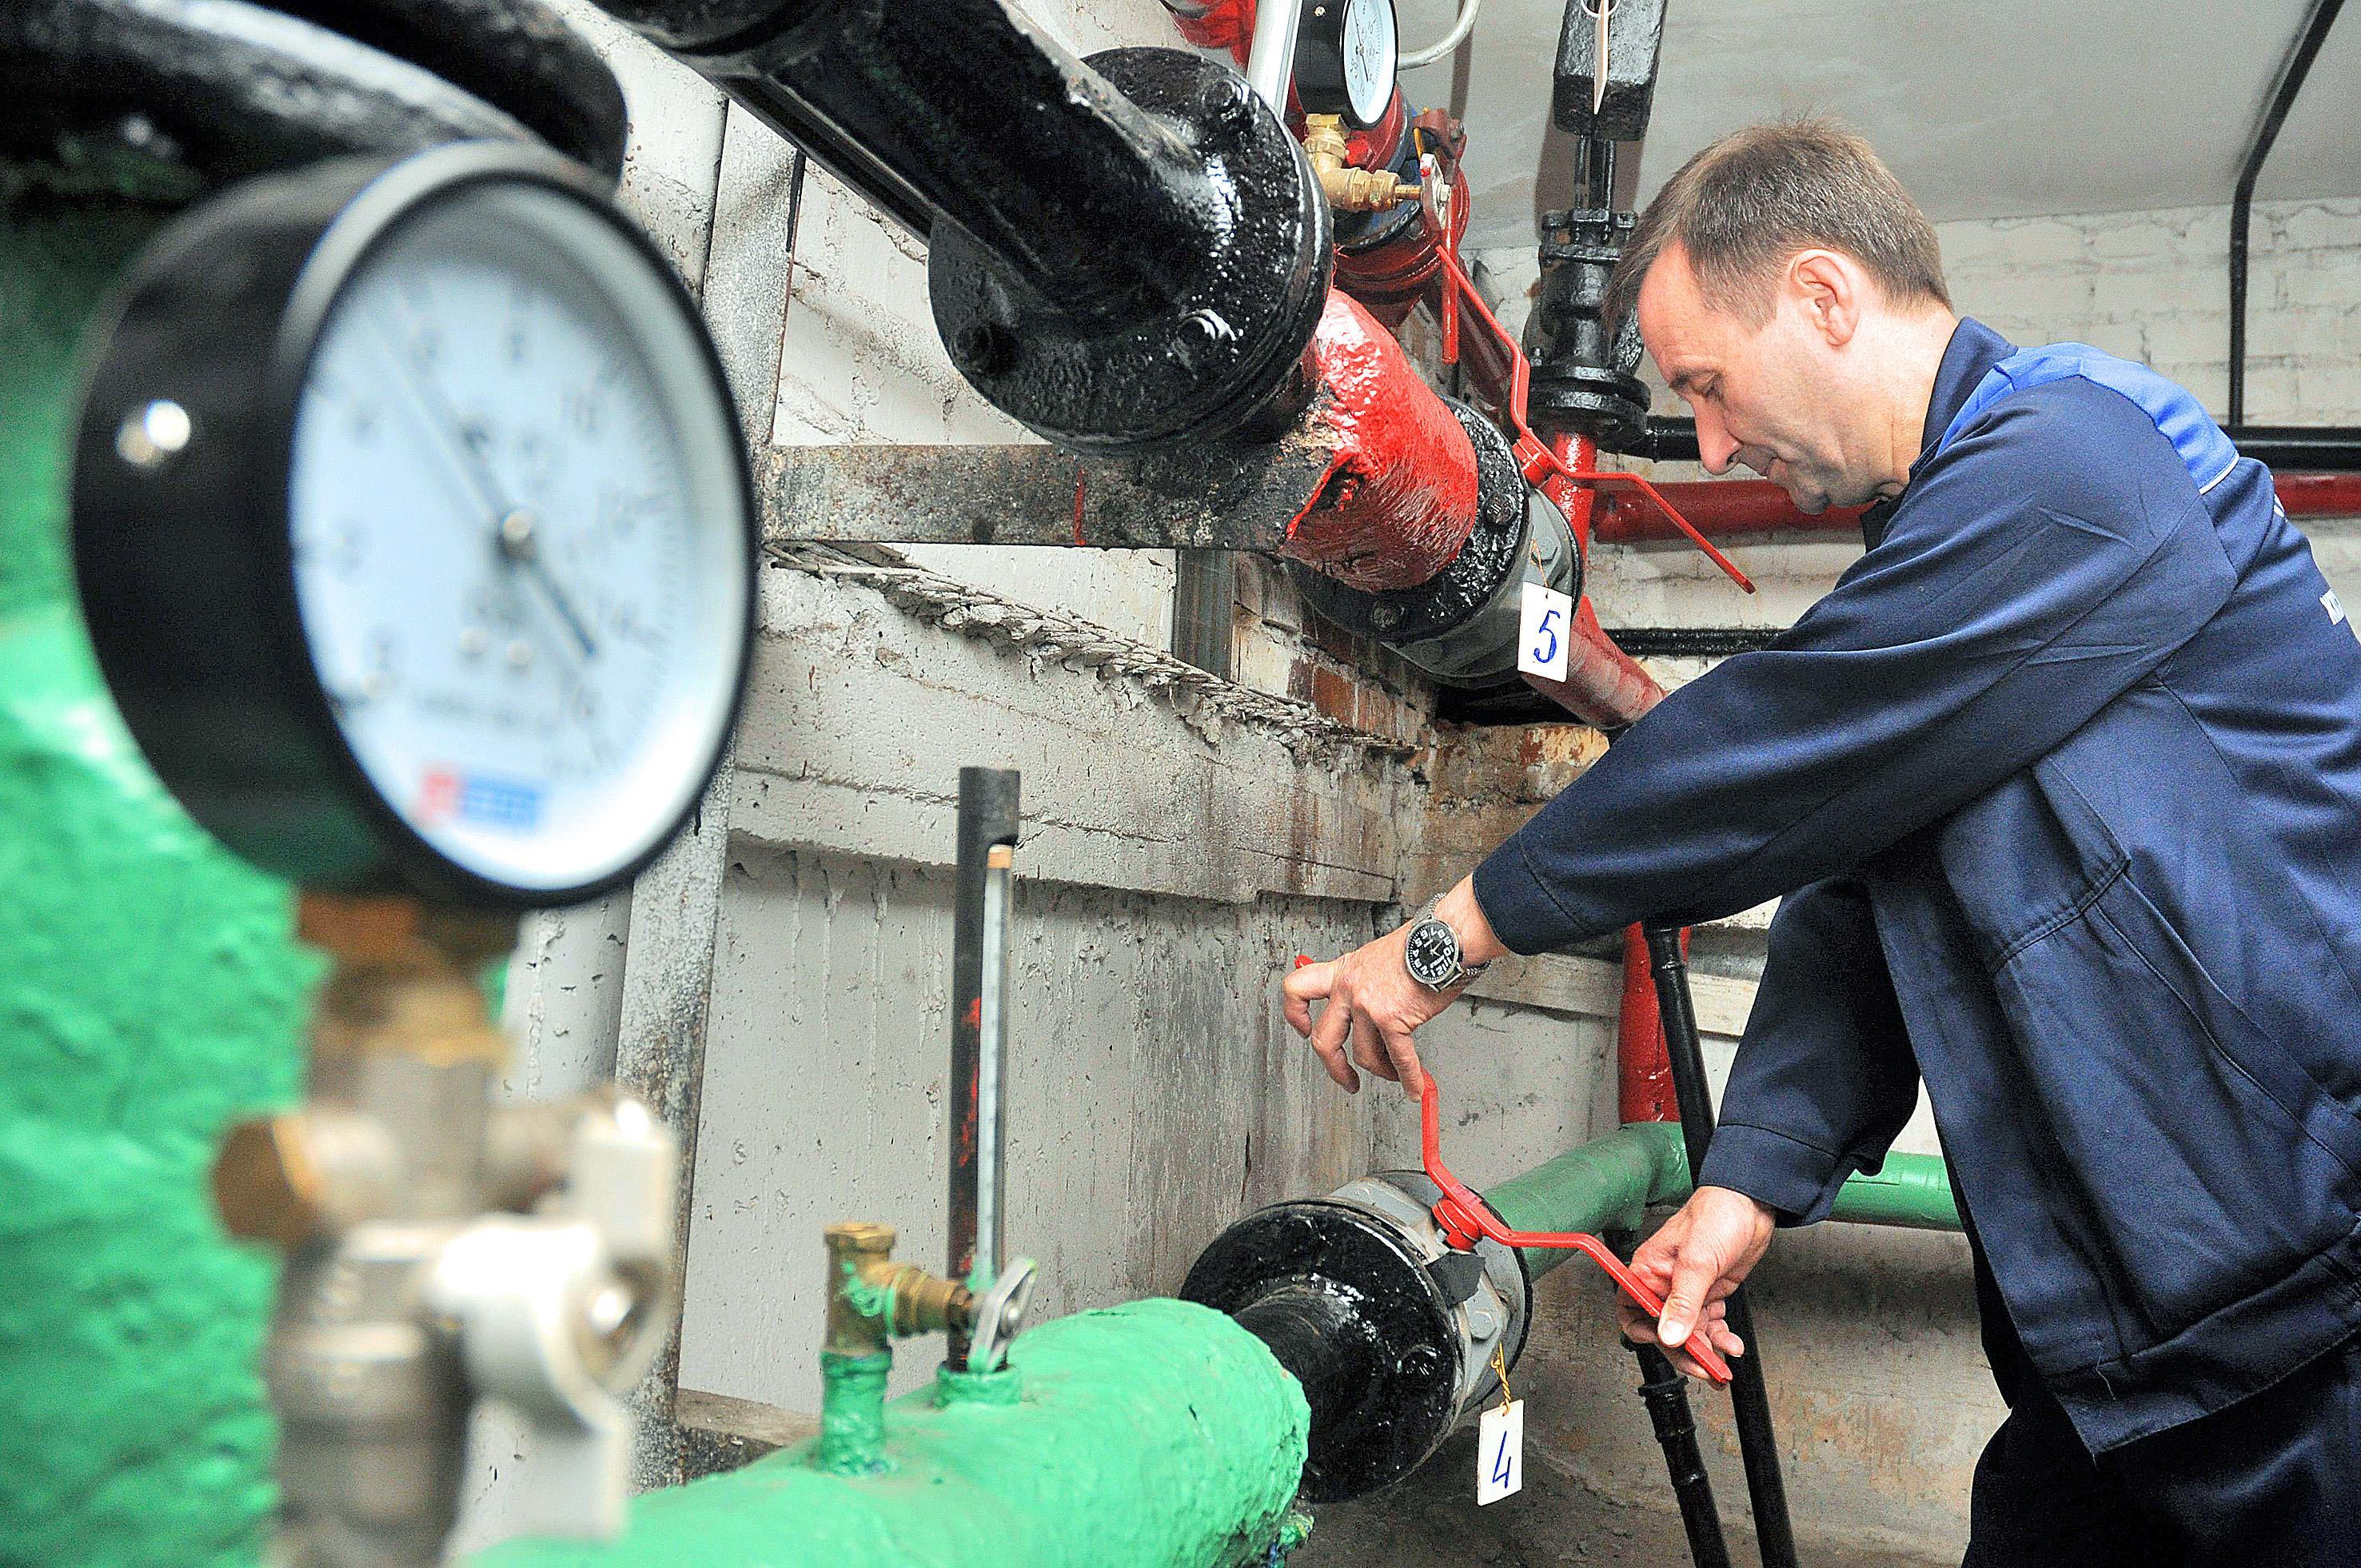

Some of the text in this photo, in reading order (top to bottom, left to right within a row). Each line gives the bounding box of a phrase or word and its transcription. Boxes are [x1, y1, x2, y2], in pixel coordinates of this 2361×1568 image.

[1533, 609, 1561, 664] 5
[1420, 929, 1428, 940] 6
[1430, 927, 1437, 936] 7
[1438, 929, 1446, 939] 8
[1414, 938, 1422, 947] 5
[1443, 936, 1451, 945] 9
[1443, 945, 1454, 956] 10
[1414, 958, 1422, 968] 3
[1443, 956, 1452, 967] 11
[1420, 965, 1429, 975] 2
[1436, 964, 1446, 976] 12
[1491, 1430, 1513, 1489] 4
